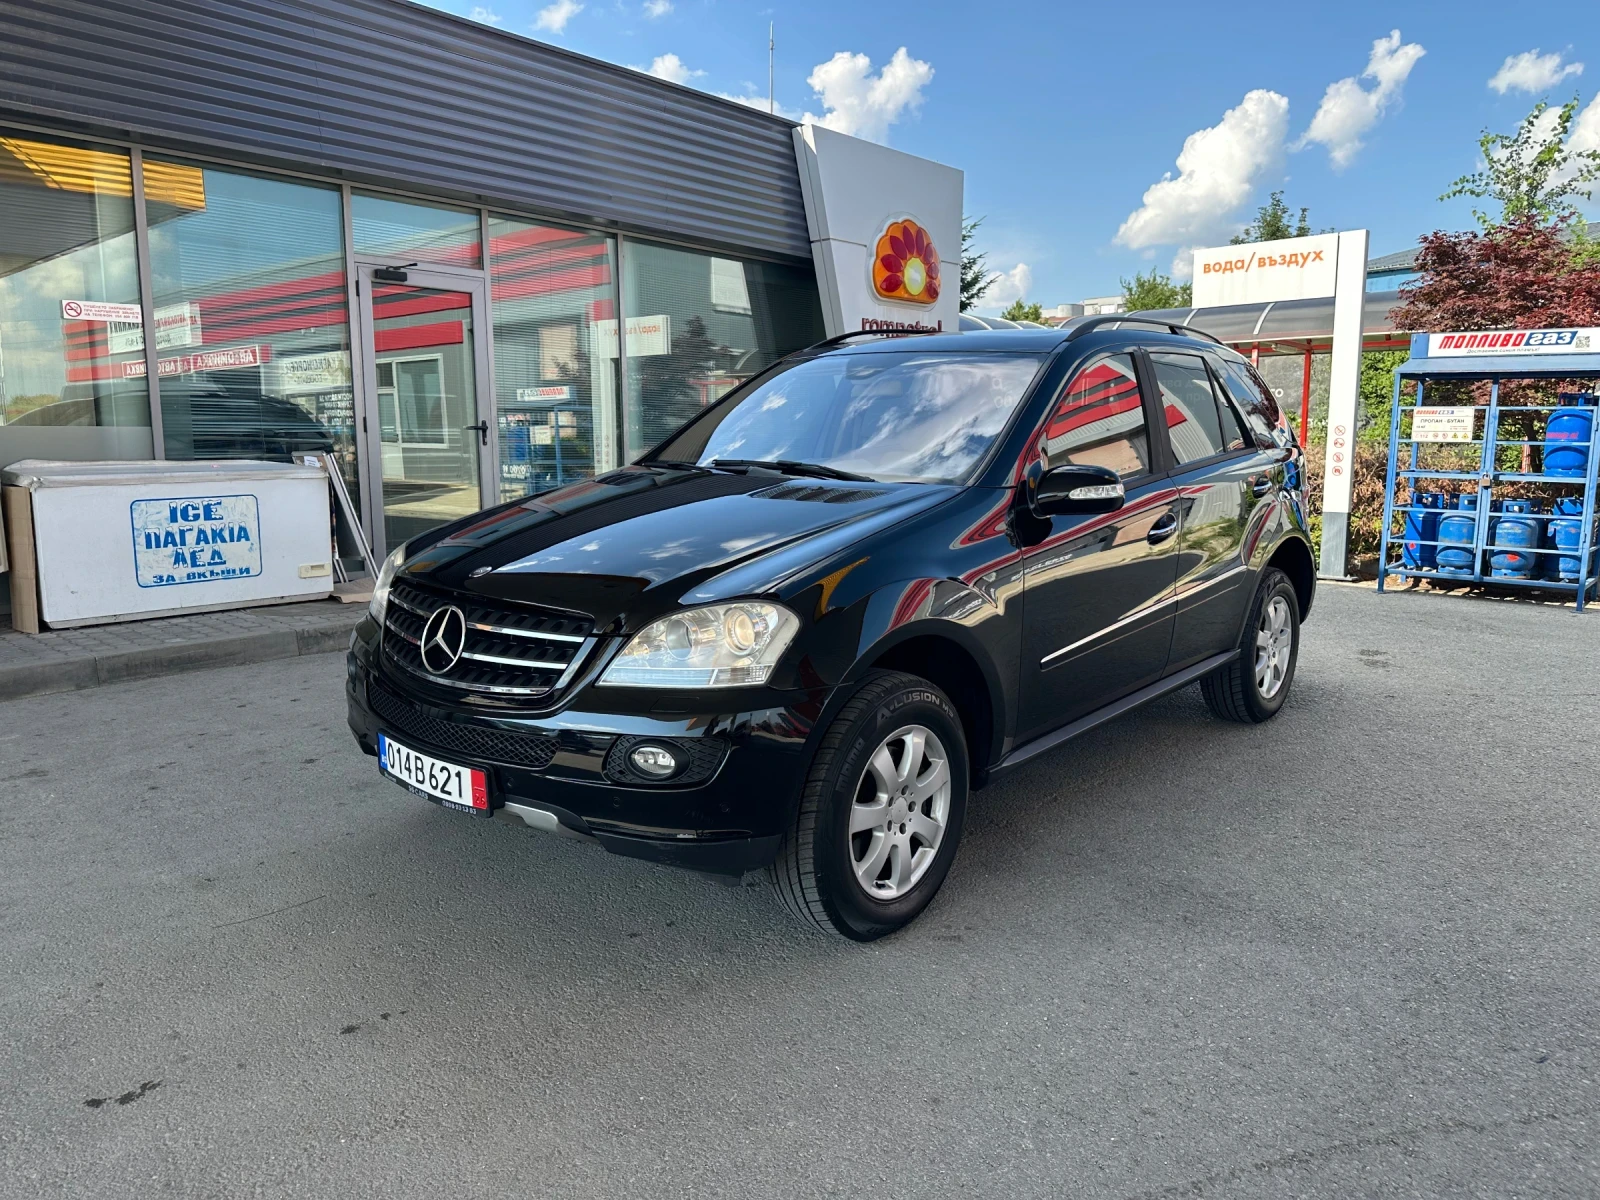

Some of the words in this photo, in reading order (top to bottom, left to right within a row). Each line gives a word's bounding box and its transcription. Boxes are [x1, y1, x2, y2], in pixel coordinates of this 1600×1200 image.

[1203, 250, 1324, 274] вода/въздух
[169, 499, 223, 523] ICE
[153, 575, 176, 583] ЗА
[388, 742, 463, 798] 014B621
